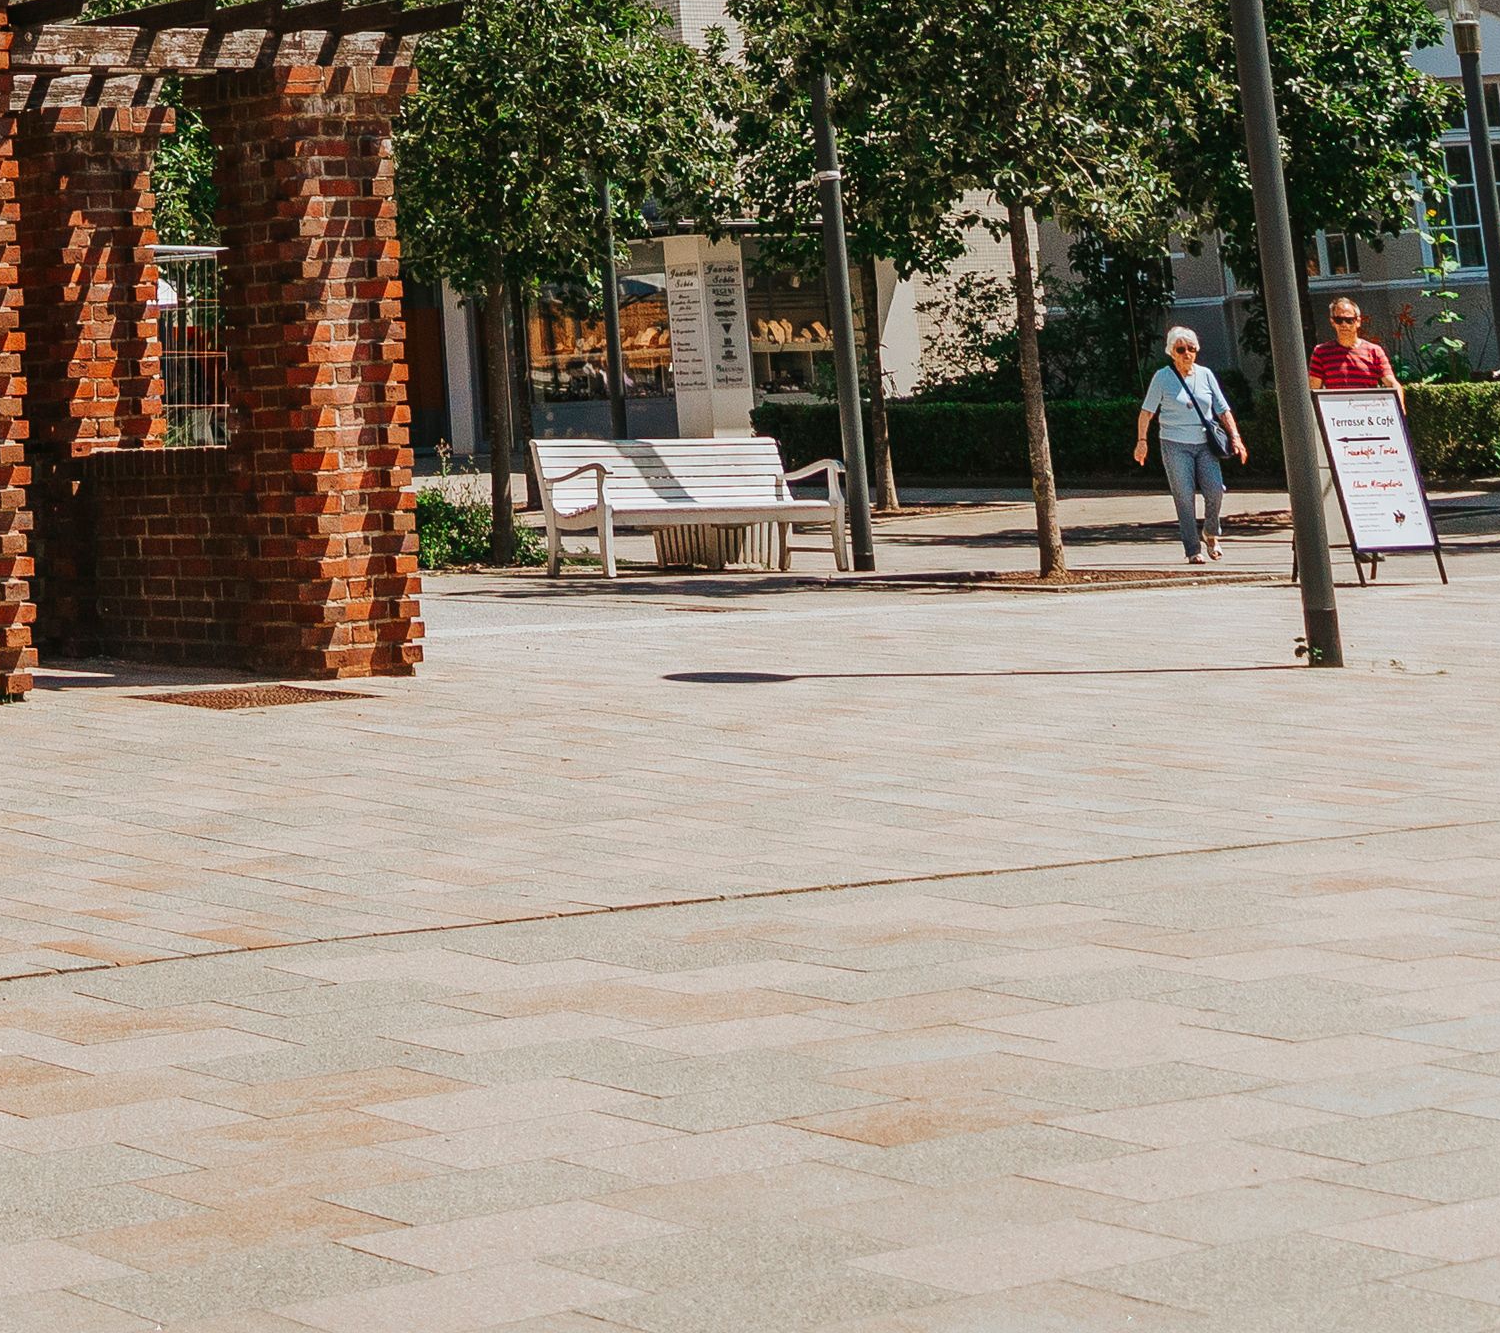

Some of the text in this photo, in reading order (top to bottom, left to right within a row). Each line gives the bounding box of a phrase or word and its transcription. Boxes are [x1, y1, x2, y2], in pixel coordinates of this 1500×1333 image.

[1331, 415, 1394, 427] Terrasse & Café
